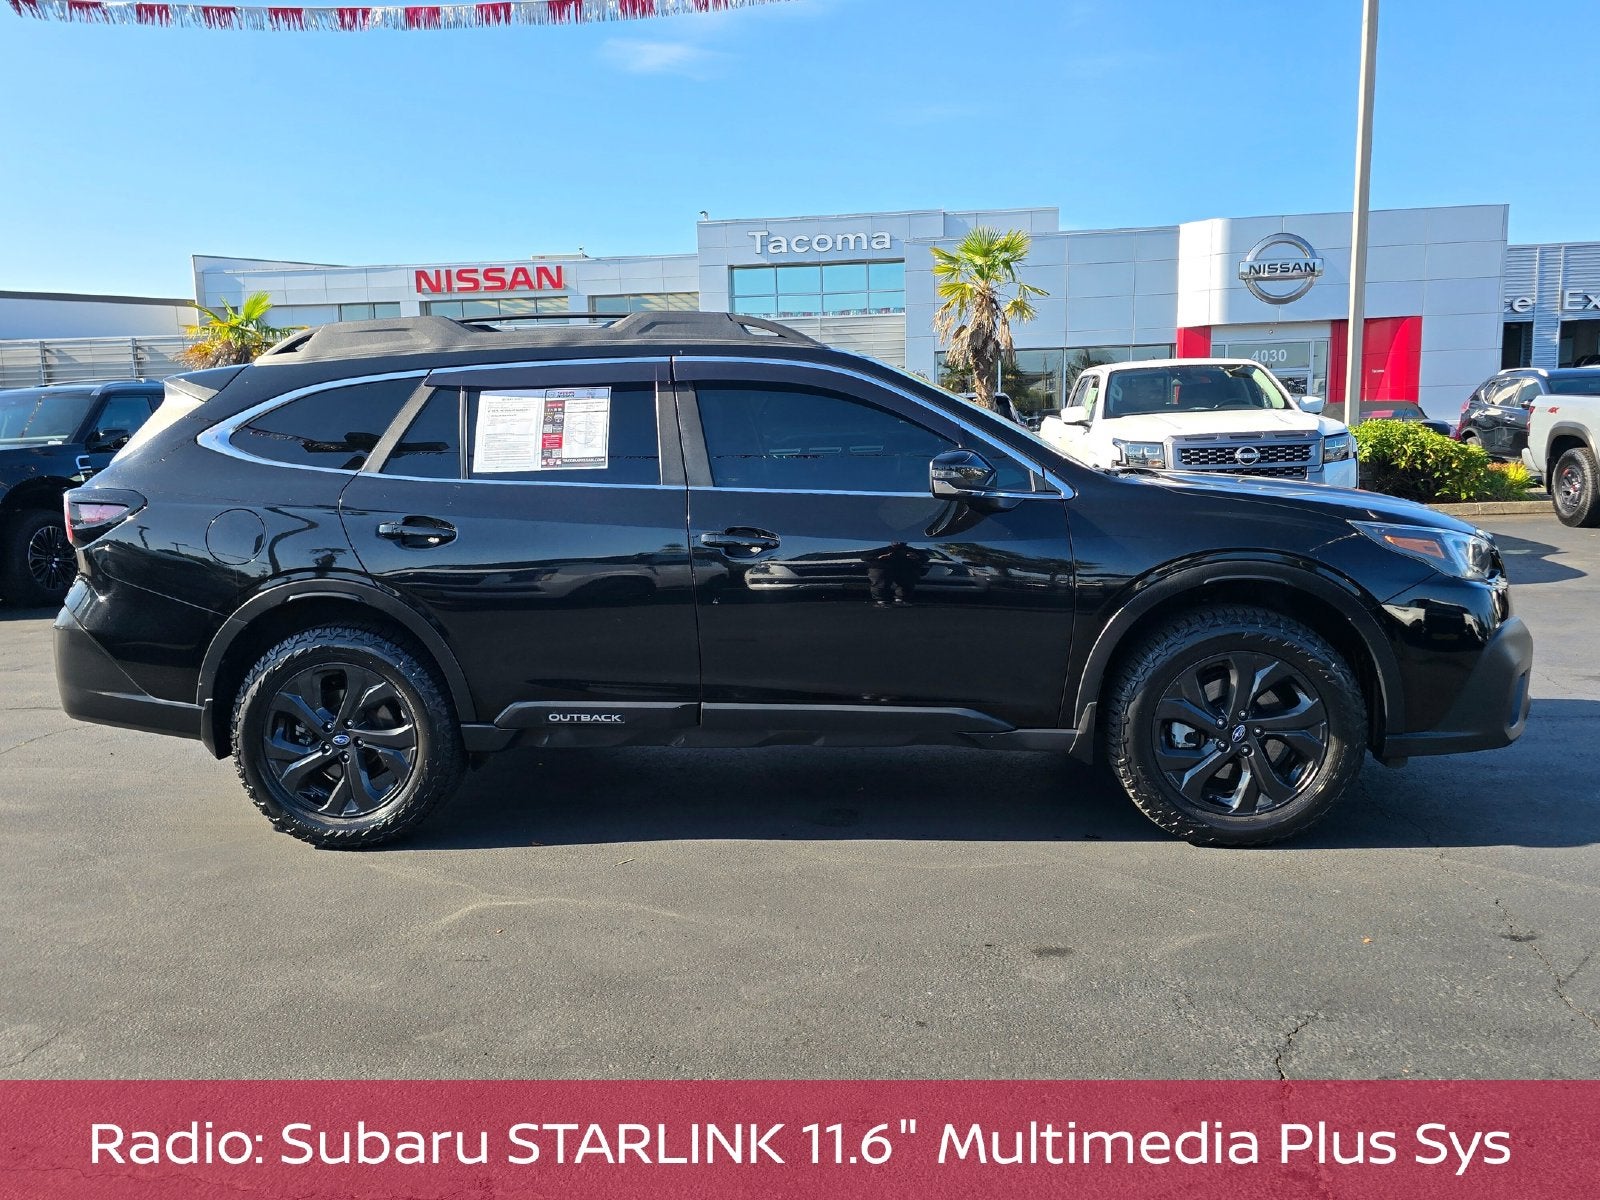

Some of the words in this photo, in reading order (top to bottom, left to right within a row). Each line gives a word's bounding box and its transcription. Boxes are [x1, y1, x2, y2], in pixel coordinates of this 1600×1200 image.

[747, 230, 892, 254] Tacoma
[1248, 261, 1316, 275] NISSAN
[415, 265, 564, 293] NISSAN
[1251, 349, 1287, 362] 4030
[548, 713, 622, 722] OUTBACK
